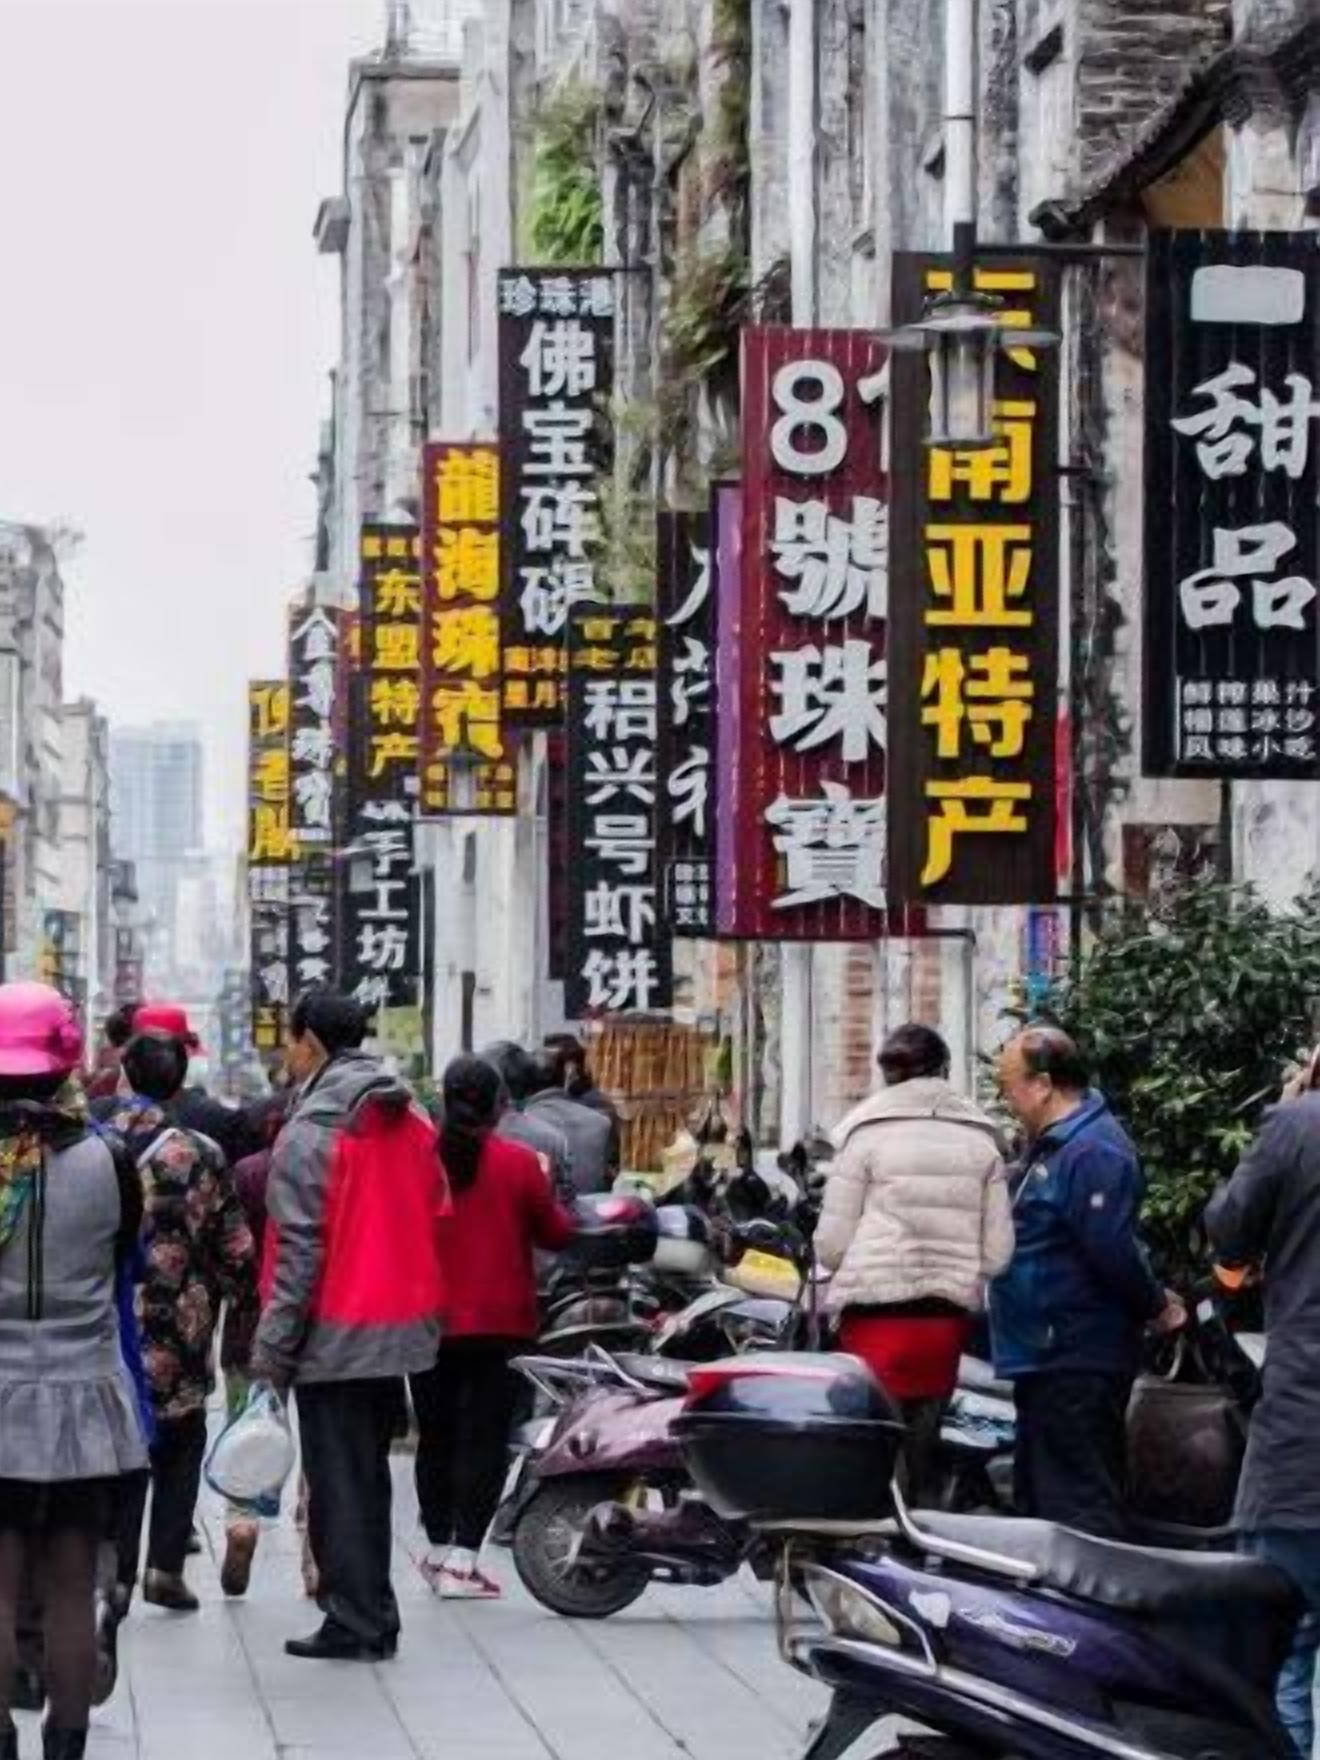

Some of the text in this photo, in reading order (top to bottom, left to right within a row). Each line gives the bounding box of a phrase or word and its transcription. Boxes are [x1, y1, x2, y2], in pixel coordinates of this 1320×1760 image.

[1170, 363, 1320, 630] 甜品
[369, 568, 421, 778] 东盟特产
